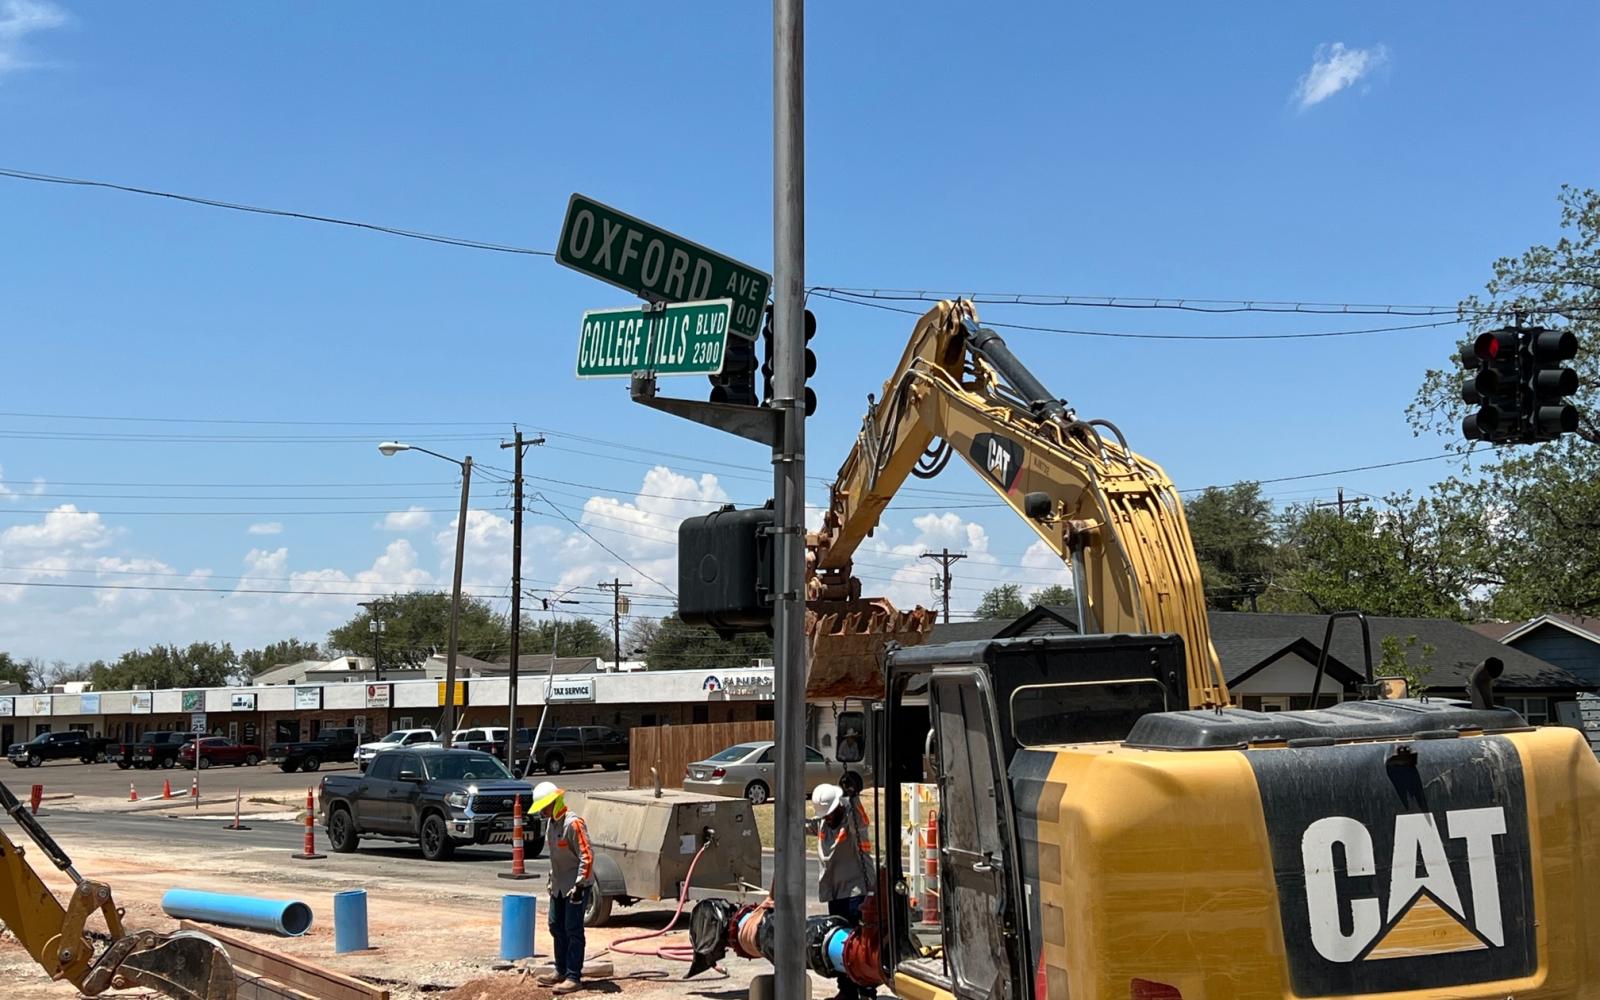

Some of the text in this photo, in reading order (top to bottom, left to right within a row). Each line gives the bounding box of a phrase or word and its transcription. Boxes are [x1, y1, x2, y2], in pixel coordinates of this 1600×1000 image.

[569, 209, 760, 301] OXFORD AVE
[580, 318, 644, 369] COLLEGE
[695, 312, 725, 336] BLVD
[692, 341, 720, 364] 2300
[986, 437, 1011, 487] CAT
[553, 686, 589, 696] TAX SERVICE
[192, 724, 205, 732] 25
[1301, 806, 1507, 963] CAT
